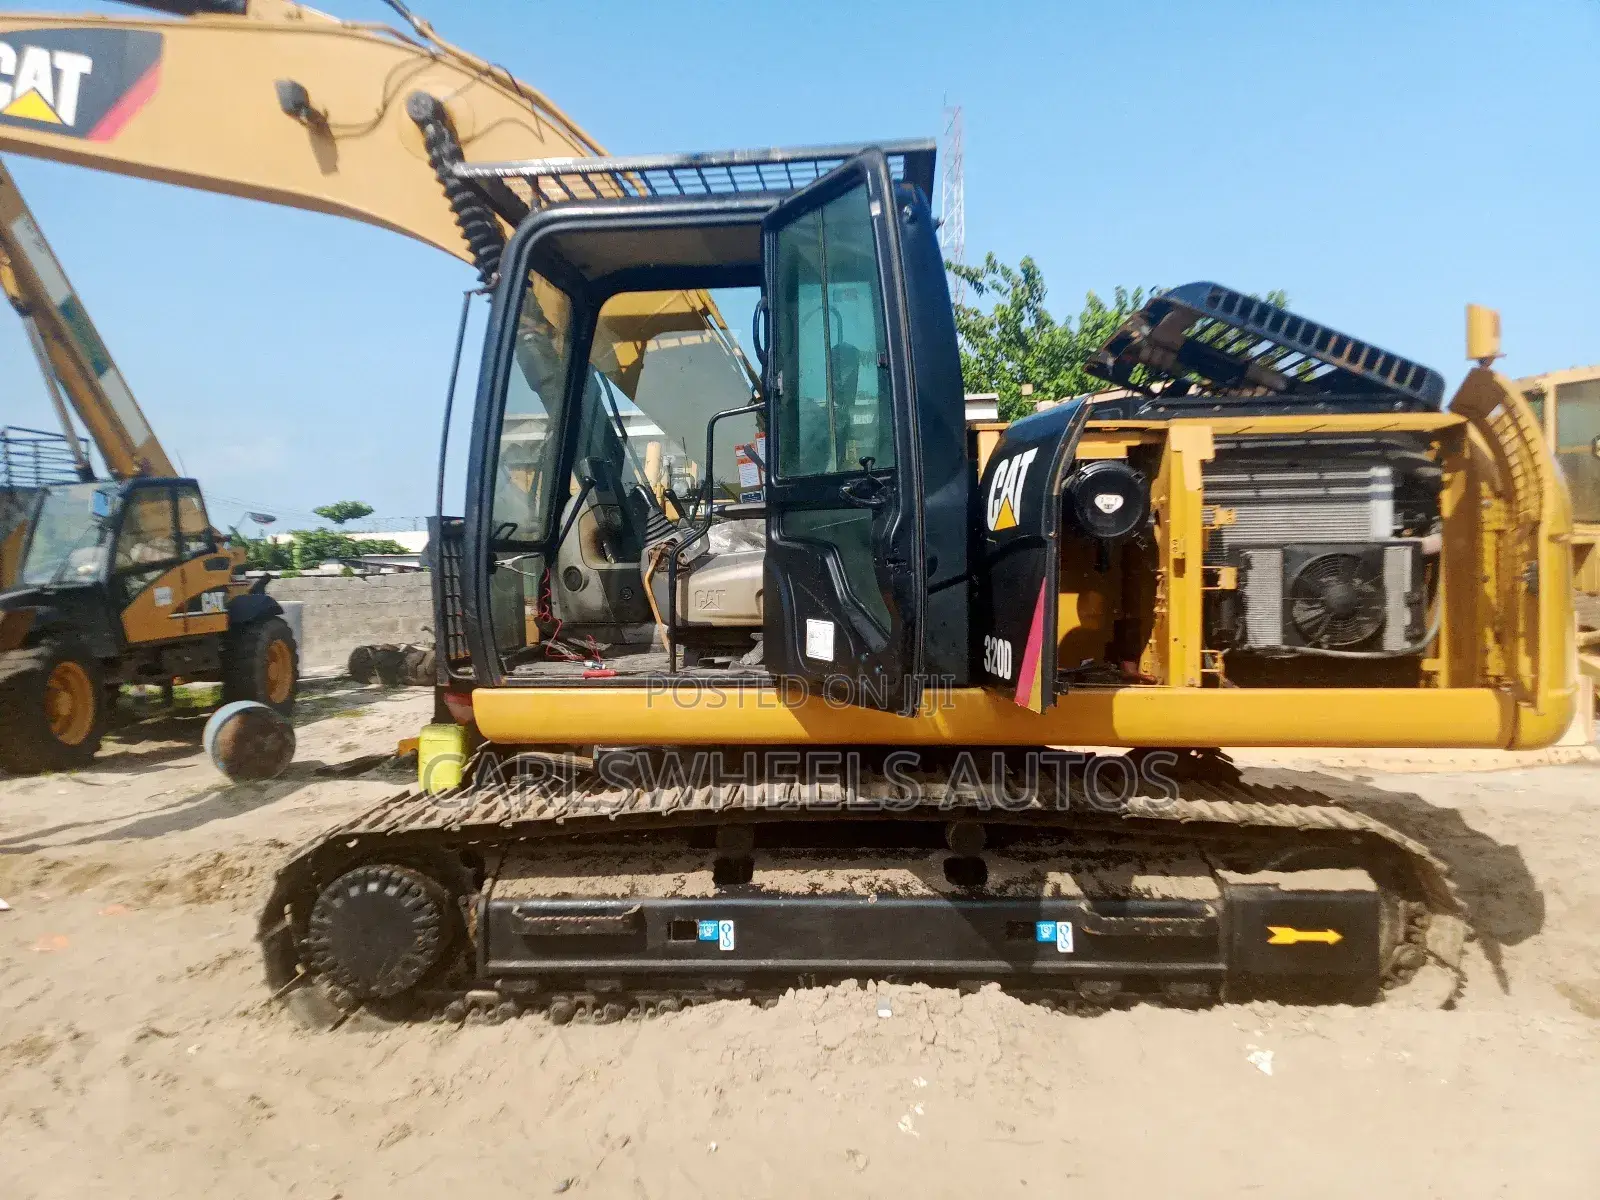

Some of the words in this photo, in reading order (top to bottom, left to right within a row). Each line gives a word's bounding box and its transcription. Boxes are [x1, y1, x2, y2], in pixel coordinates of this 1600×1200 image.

[987, 446, 1039, 532] CAT
[694, 589, 726, 611] CAT
[983, 634, 1012, 680] 320D
